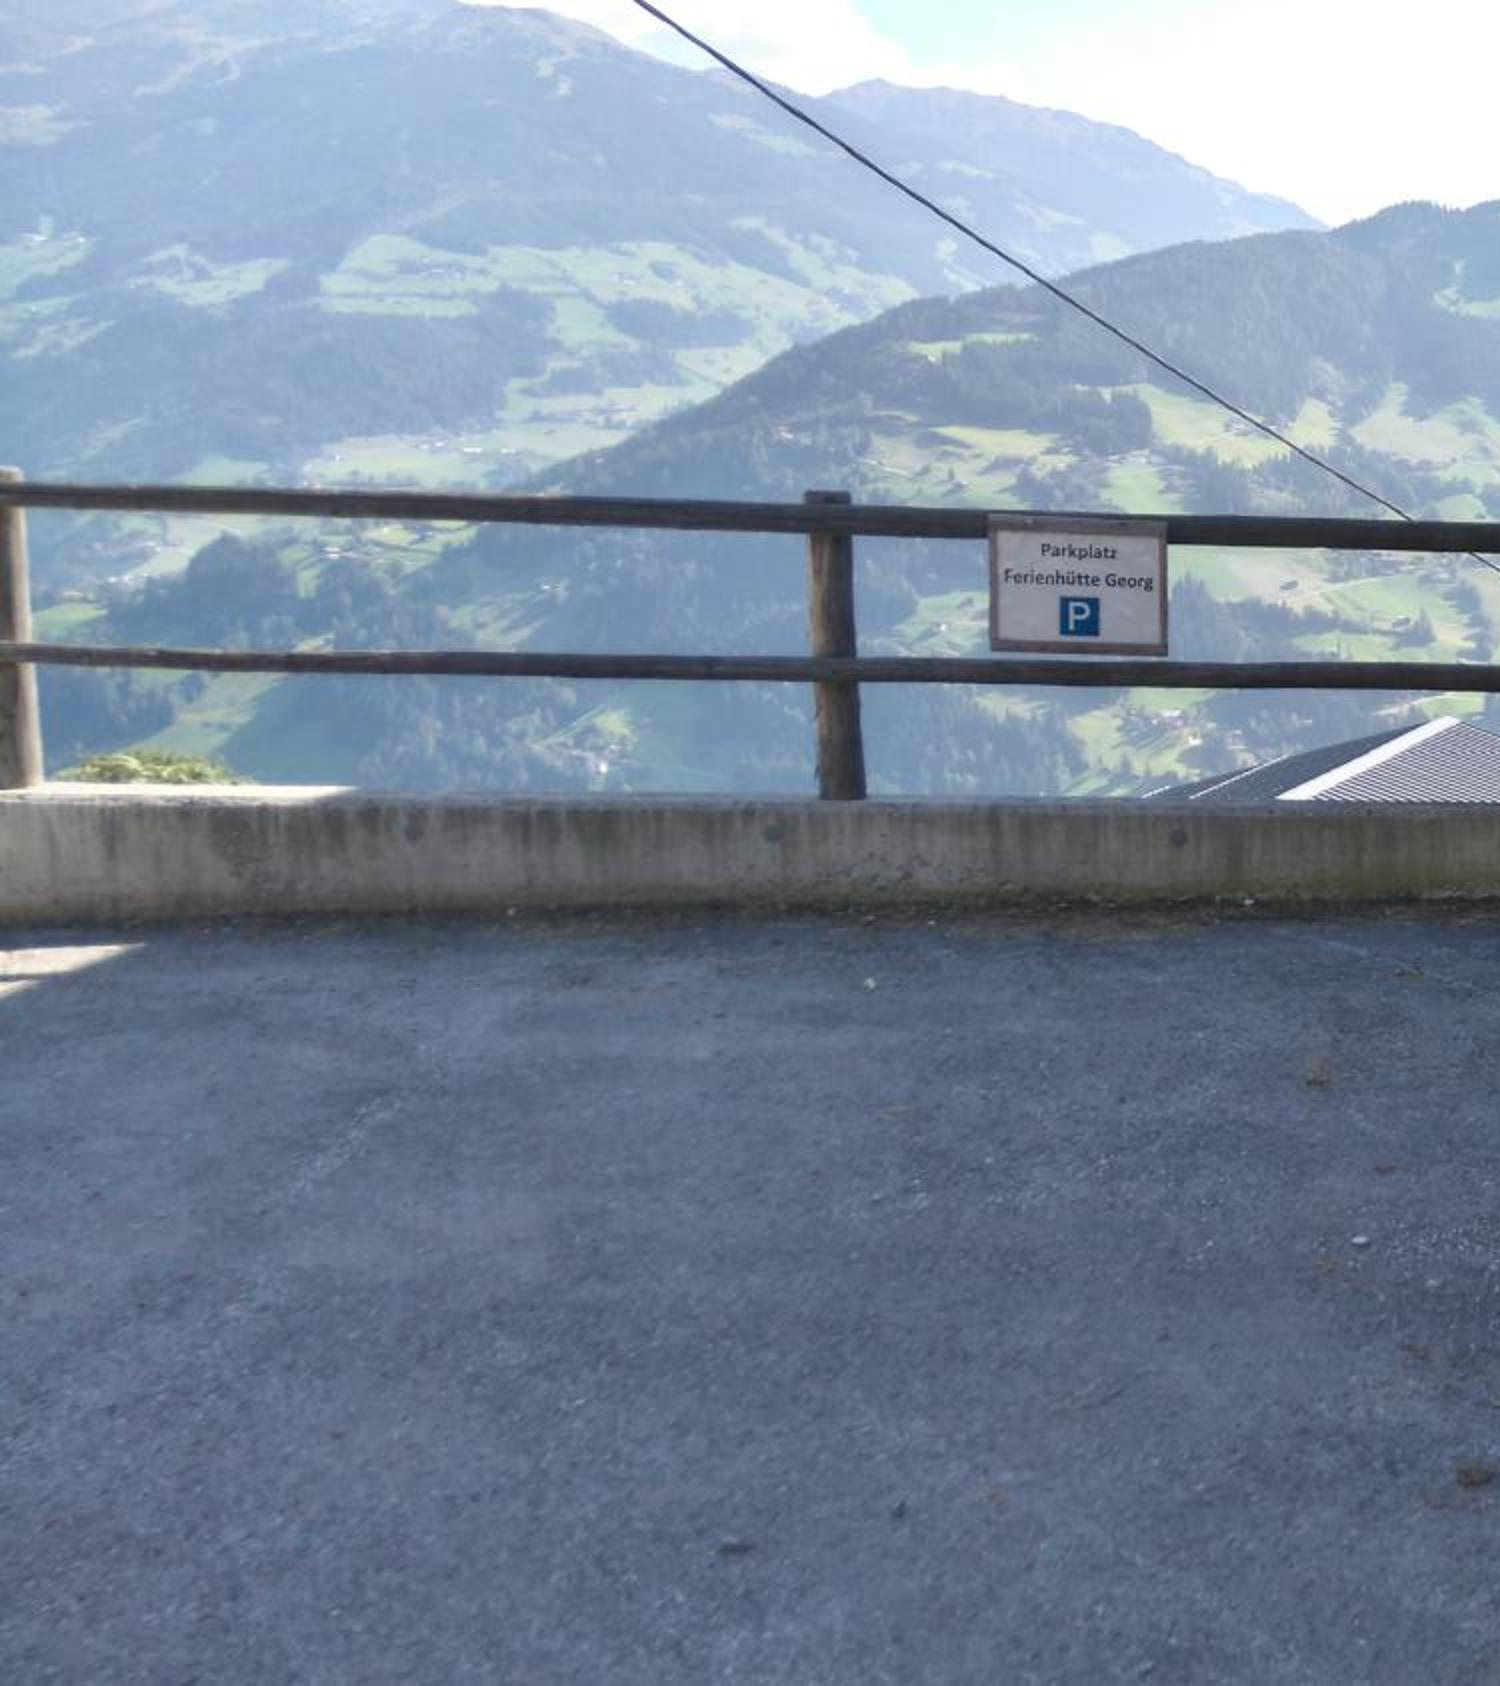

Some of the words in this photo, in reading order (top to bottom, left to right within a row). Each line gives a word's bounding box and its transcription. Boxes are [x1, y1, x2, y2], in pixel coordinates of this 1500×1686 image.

[1041, 543, 1117, 560] Parkplatz
[1004, 568, 1100, 587] Ferienhütte
[1105, 573, 1153, 592] Georg
[1068, 601, 1091, 631] P
